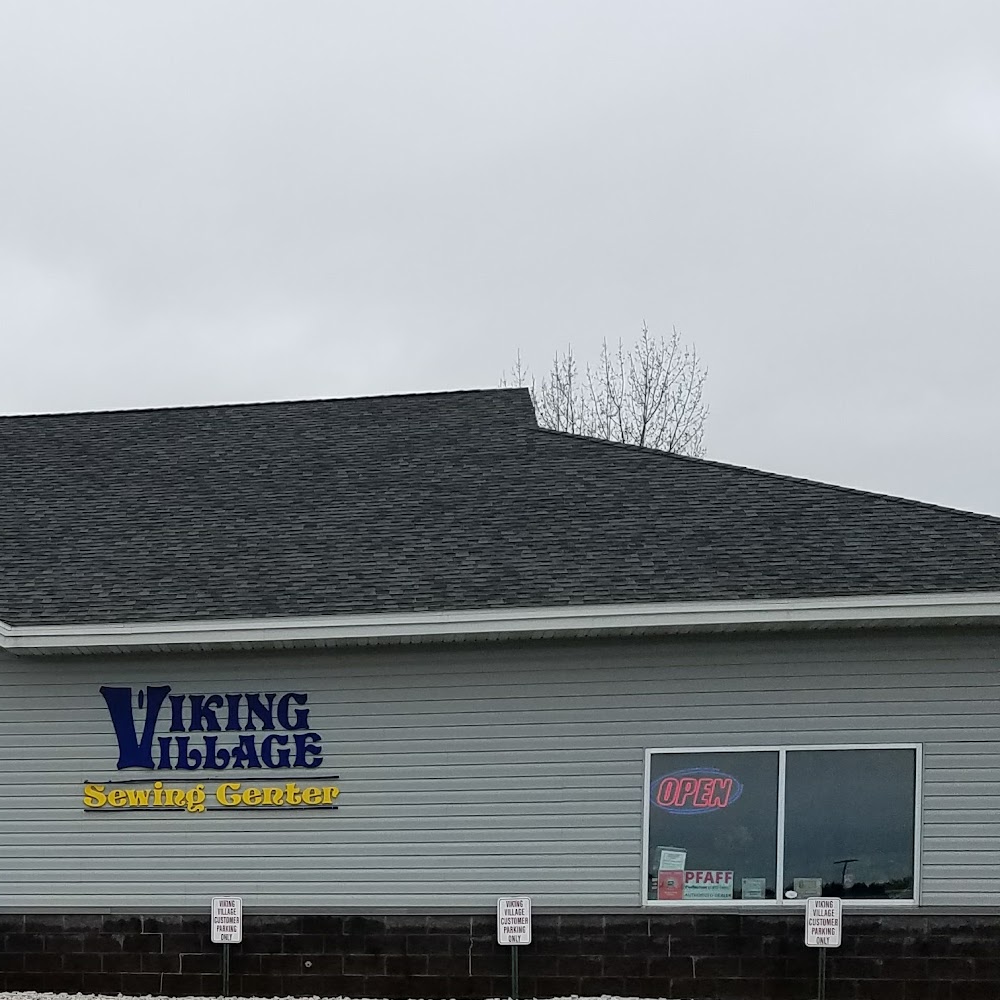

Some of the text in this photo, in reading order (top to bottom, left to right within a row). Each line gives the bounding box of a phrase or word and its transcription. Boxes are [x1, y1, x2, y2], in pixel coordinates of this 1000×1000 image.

[100, 685, 310, 770] VIKING
[83, 781, 340, 812] Sewing Center
[656, 777, 733, 808] OPEN
[685, 871, 733, 884] PFAFF
[505, 900, 523, 908] VIKING
[815, 900, 833, 908] VIKING
[504, 908, 525, 916] VILLAGE
[812, 909, 835, 917] VILLAGE
[214, 916, 239, 924] CUSTOMER
[501, 917, 528, 925] CUSTOMER
[809, 918, 838, 926] CUSTOMER
[503, 926, 526, 934] PARKING
[811, 927, 835, 936] PARKING
[221, 933, 232, 941] ONLY
[508, 935, 521, 943] ONLY
[816, 936, 830, 945] ONLY
